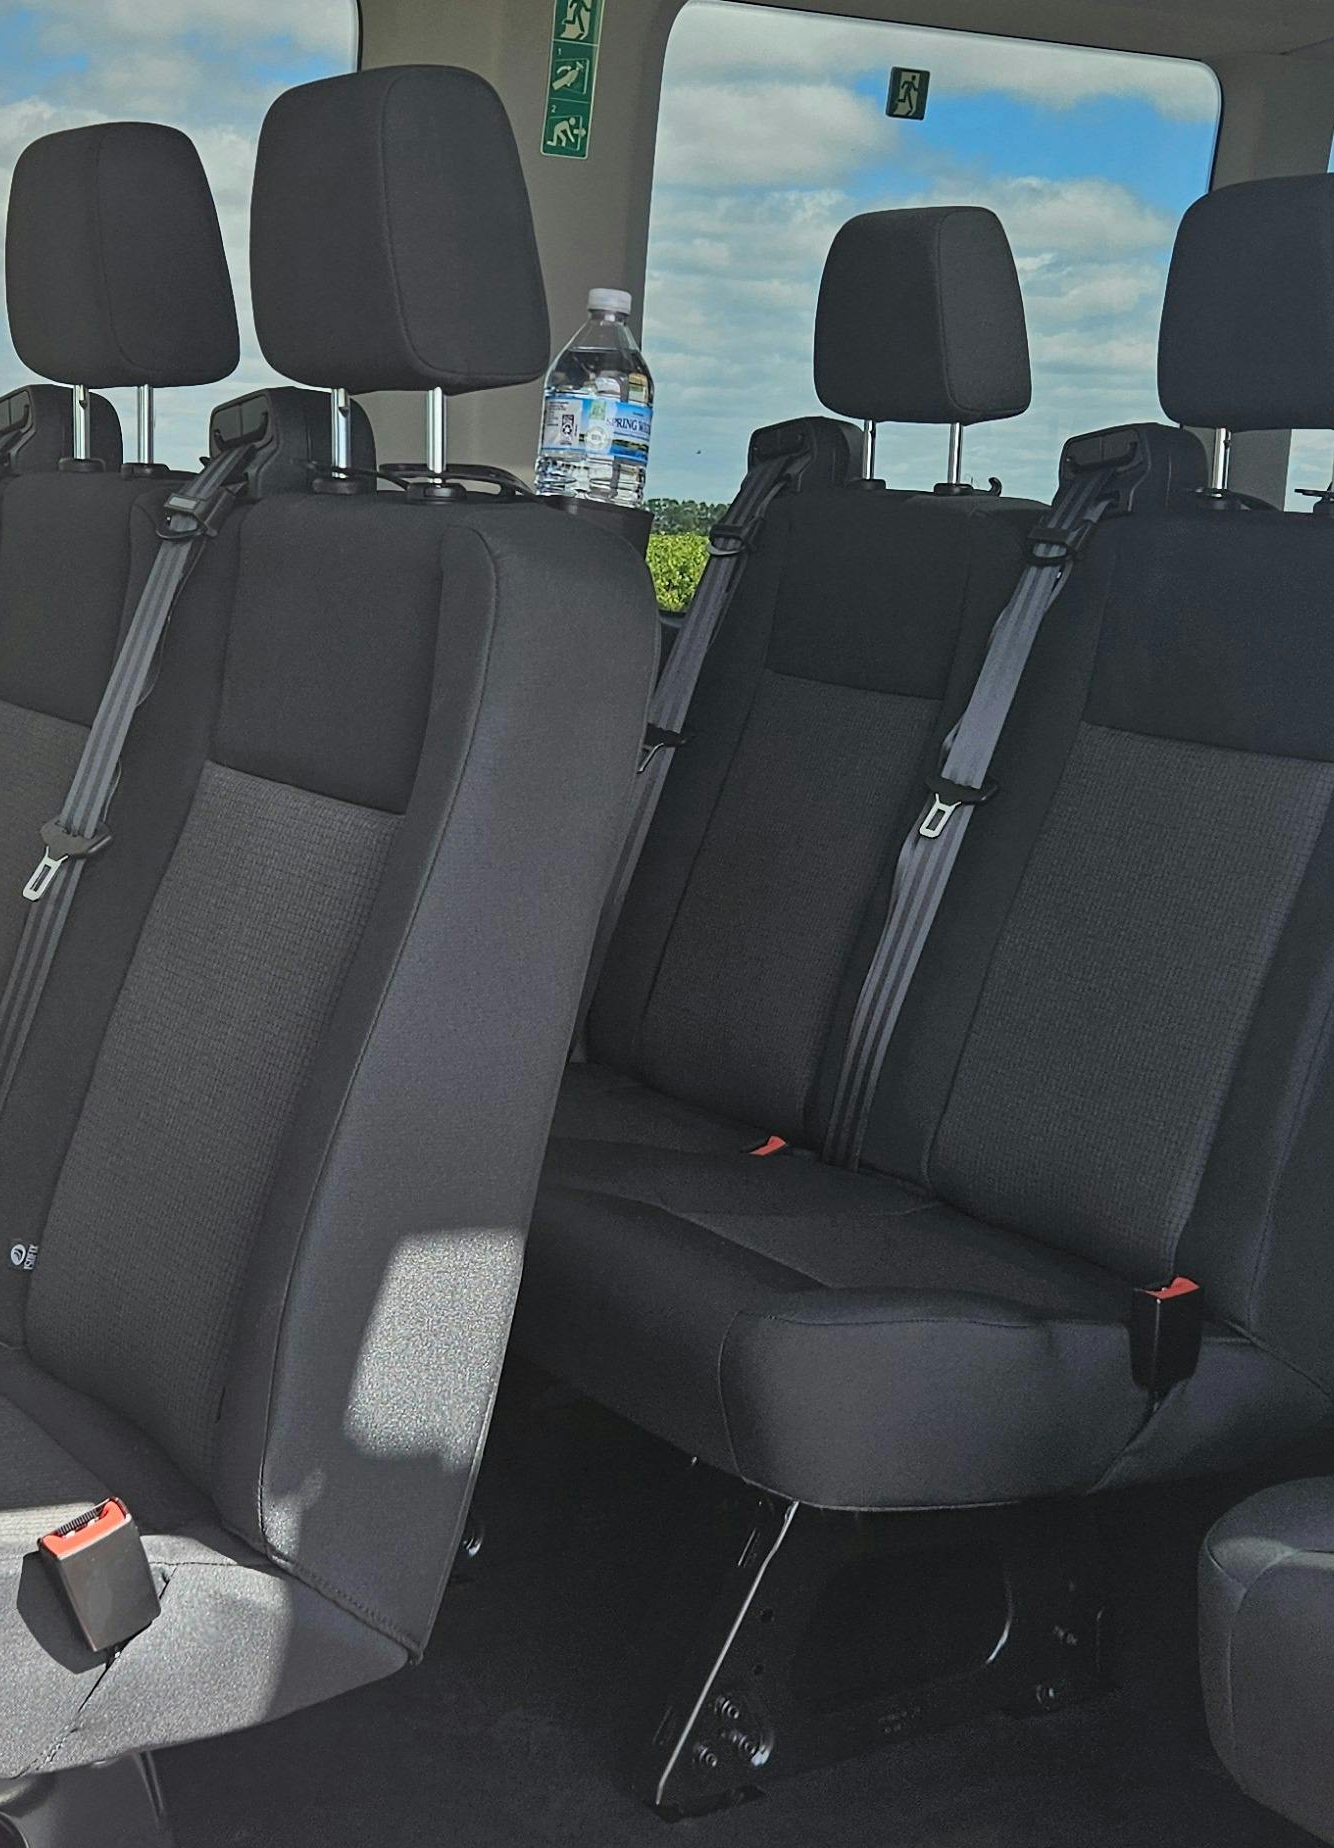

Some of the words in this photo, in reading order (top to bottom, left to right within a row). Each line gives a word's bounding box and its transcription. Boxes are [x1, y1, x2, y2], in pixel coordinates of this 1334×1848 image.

[557, 47, 562, 56] 1
[550, 104, 557, 114] 2
[606, 416, 638, 431] SPRING
